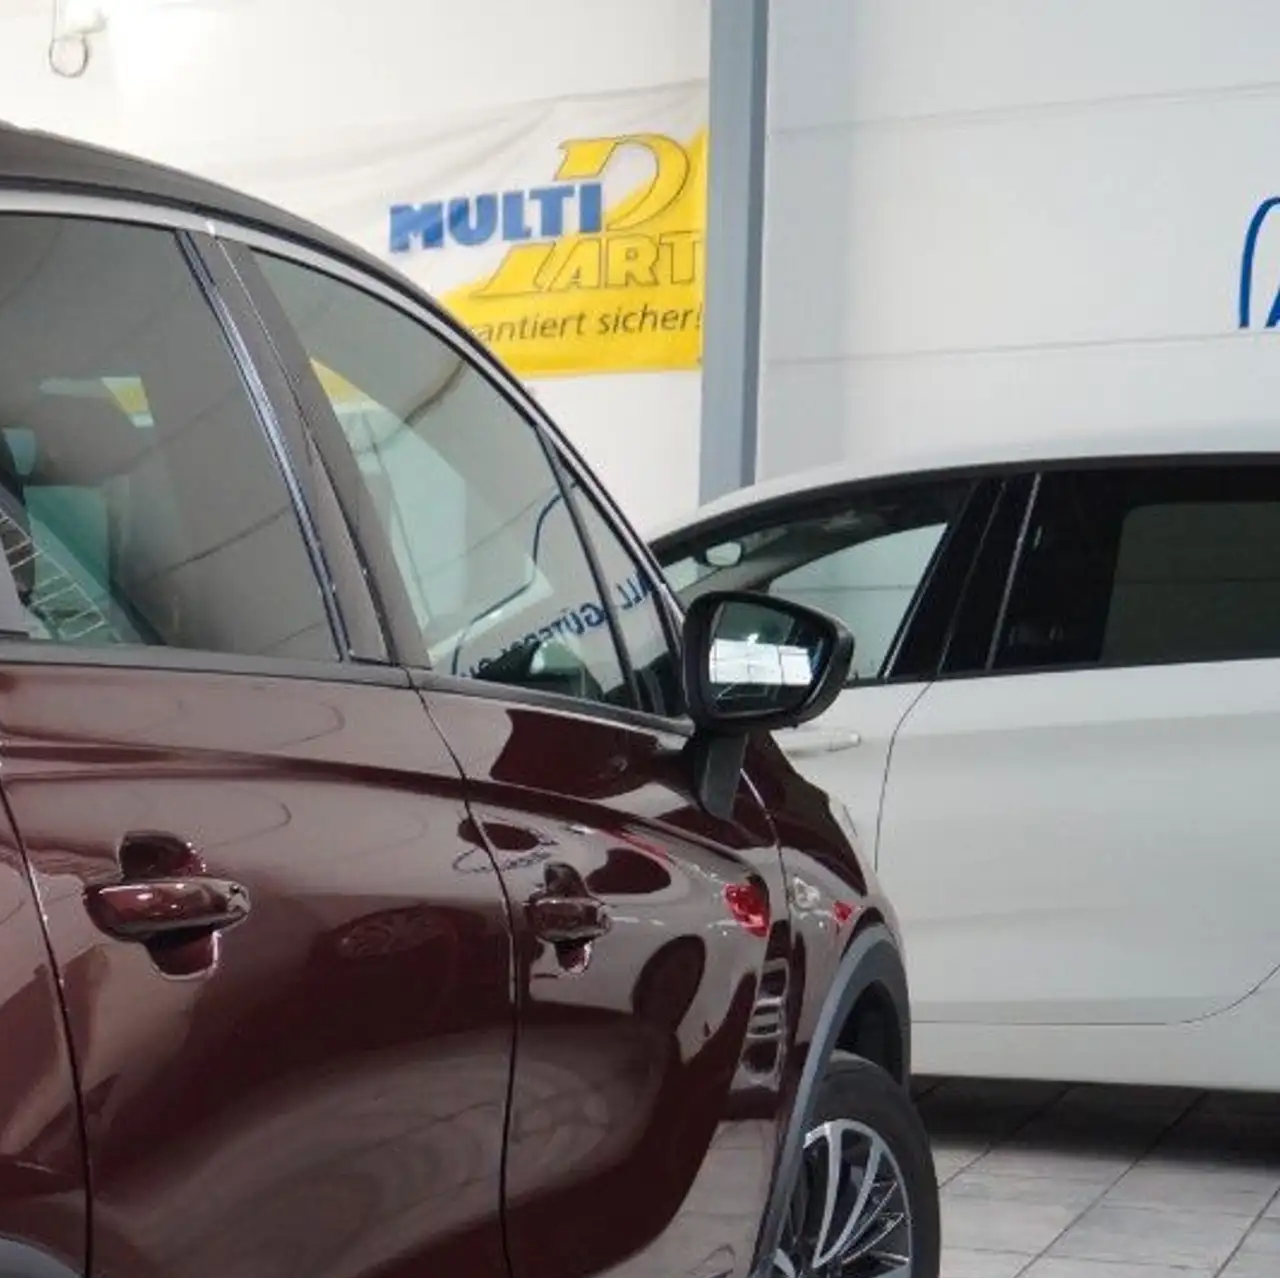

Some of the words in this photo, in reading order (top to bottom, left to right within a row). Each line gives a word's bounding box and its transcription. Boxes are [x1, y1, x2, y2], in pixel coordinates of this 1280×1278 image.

[389, 183, 602, 254] MULTI
[469, 133, 703, 299] PART
[474, 311, 588, 343] antiert
[597, 302, 703, 335] sicher!
